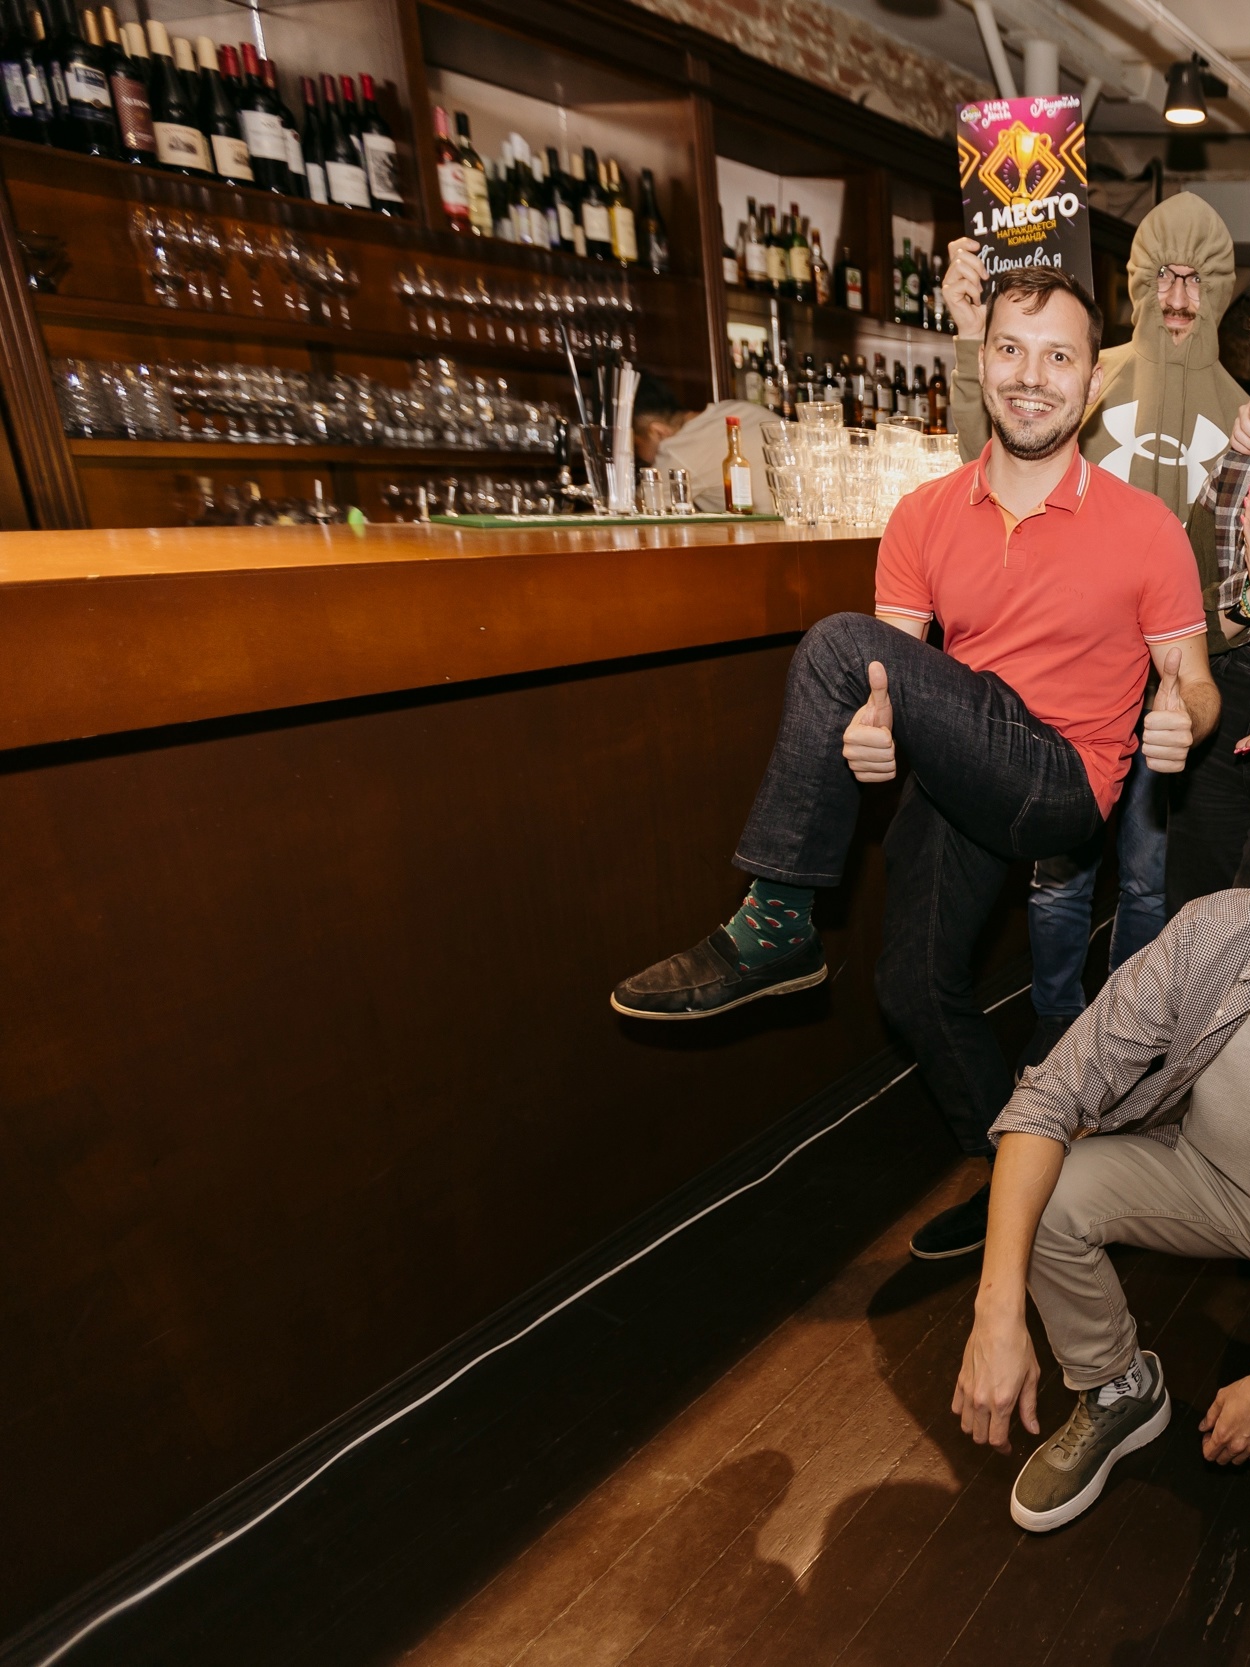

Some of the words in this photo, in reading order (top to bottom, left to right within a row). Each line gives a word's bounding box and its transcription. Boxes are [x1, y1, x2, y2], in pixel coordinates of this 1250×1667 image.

[973, 211, 988, 236] 1
[991, 192, 1079, 232] МЕСТО
[996, 219, 1057, 239] НАГРАЖДАЕТСЯ
[1007, 231, 1047, 246] КОМАНДА
